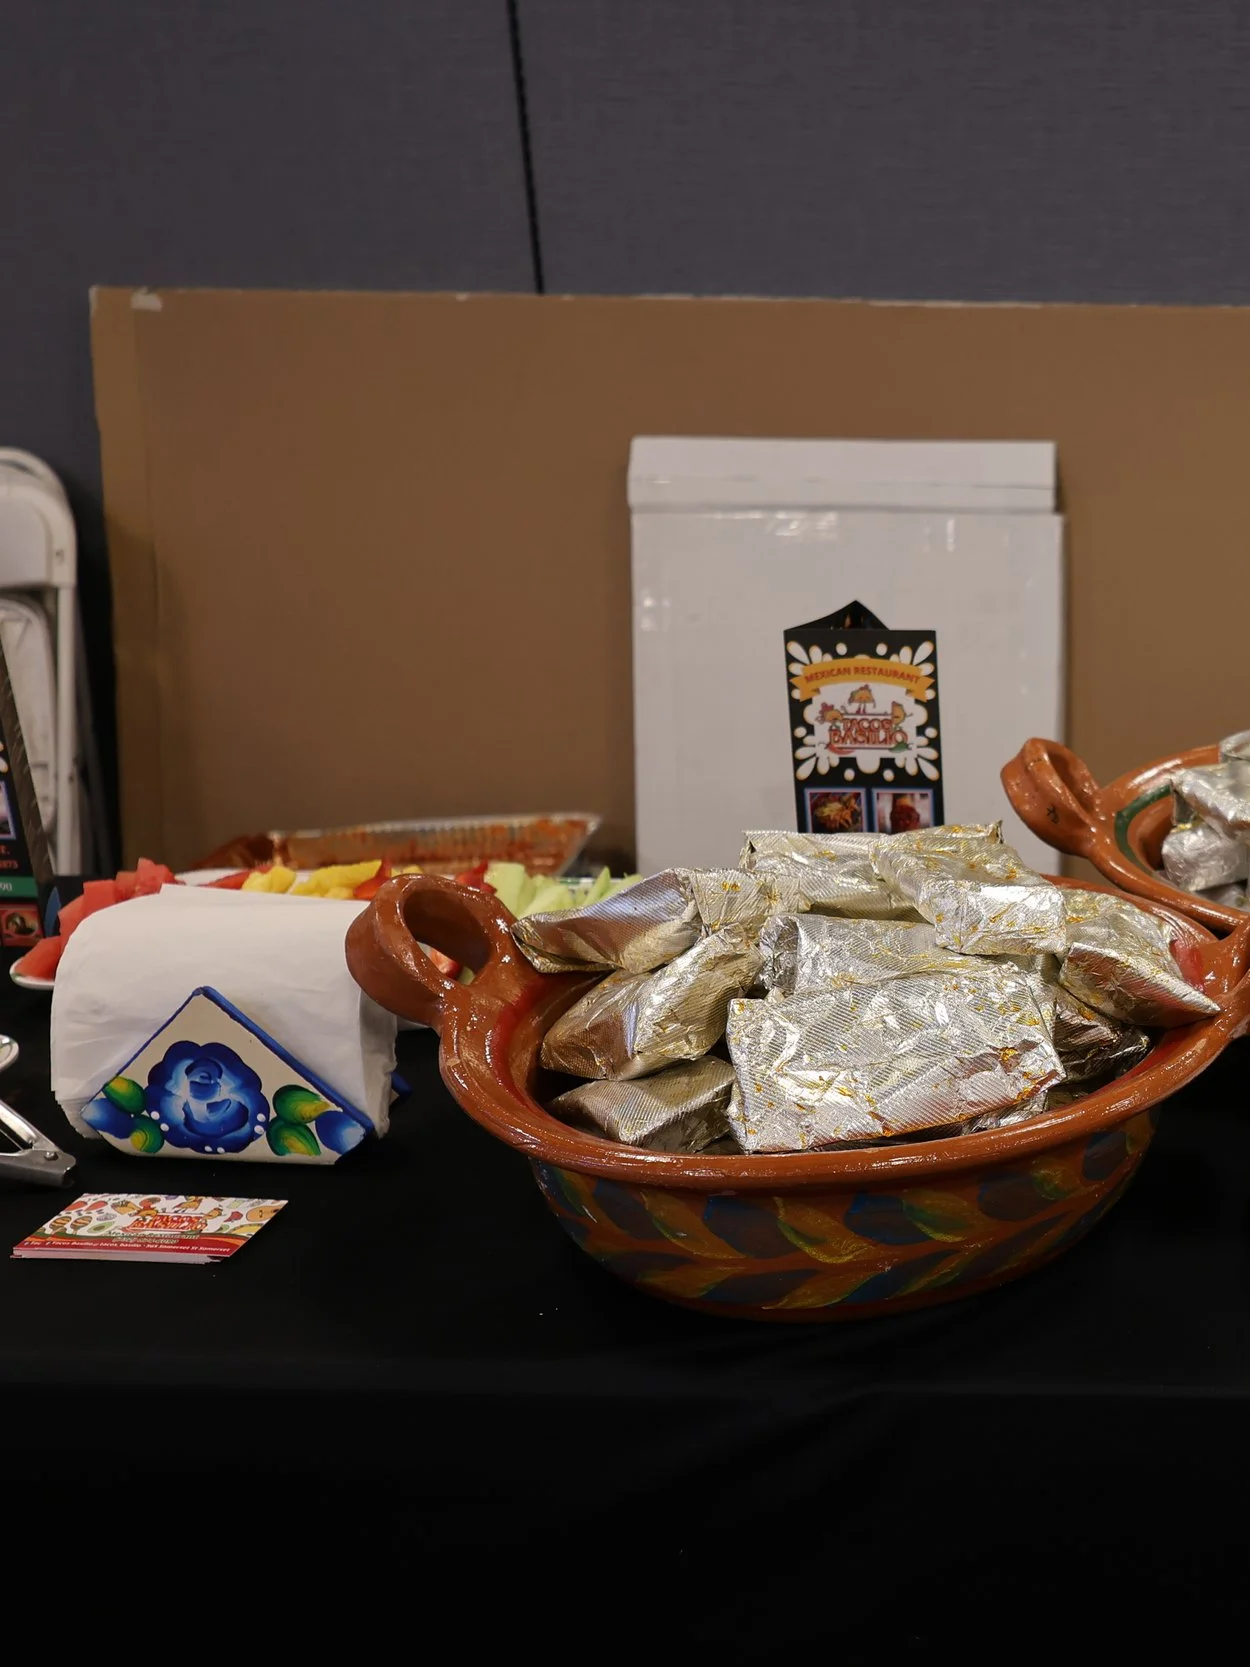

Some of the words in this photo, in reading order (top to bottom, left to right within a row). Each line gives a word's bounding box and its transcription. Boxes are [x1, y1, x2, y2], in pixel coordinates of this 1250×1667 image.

[805, 666, 851, 684] MEXICAN
[853, 665, 921, 685] RESTAURANT
[841, 718, 893, 732] TACOS
[829, 728, 909, 746] BASILIO
